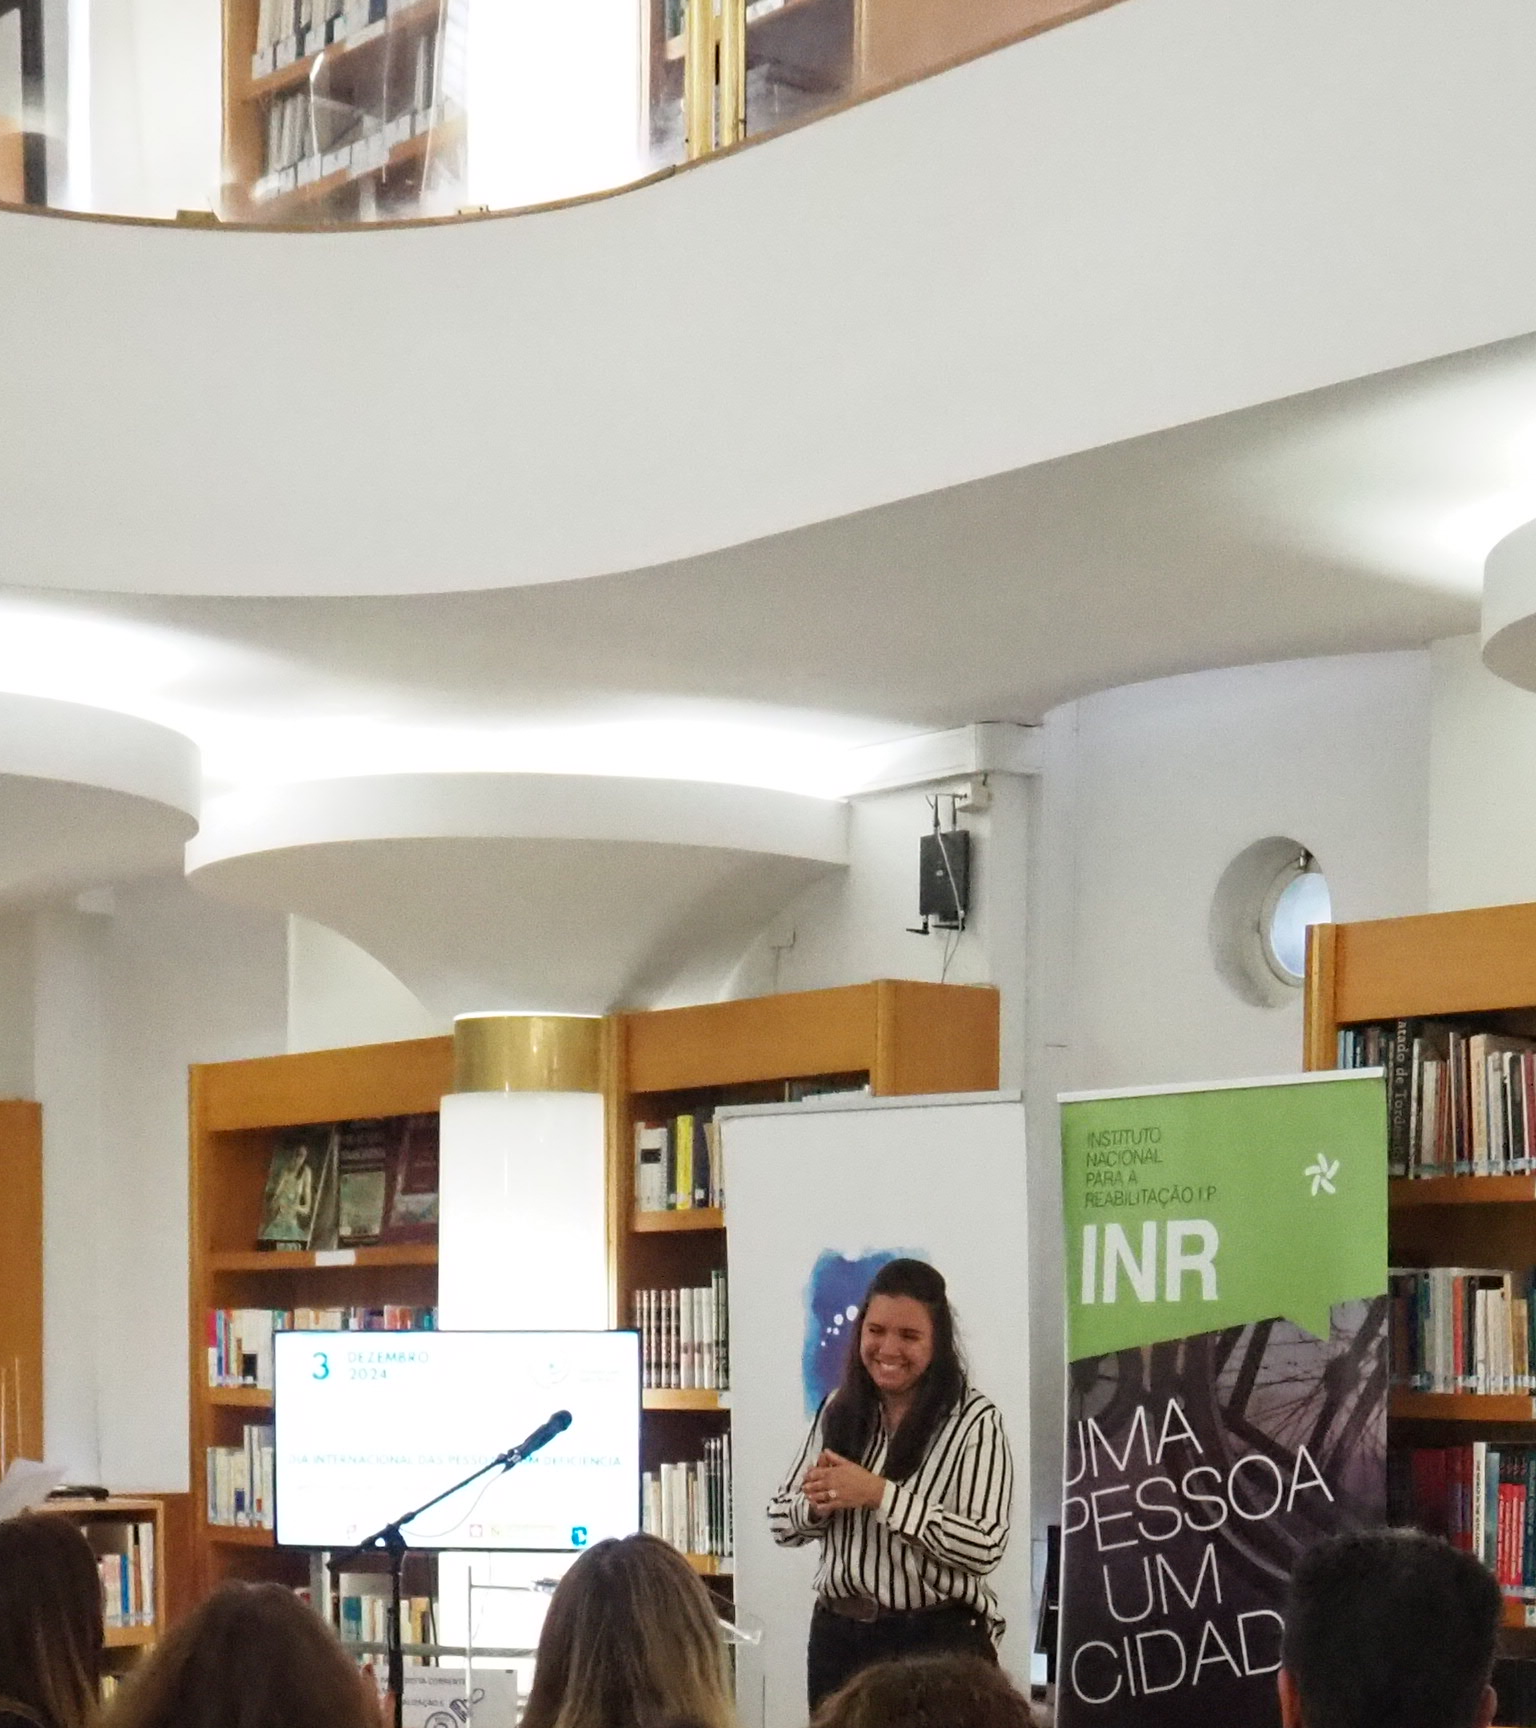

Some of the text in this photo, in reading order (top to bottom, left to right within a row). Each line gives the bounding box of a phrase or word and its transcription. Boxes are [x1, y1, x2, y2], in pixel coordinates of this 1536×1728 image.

[1087, 1127, 1161, 1148] INSTITUTO
[1086, 1148, 1163, 1168] NACIONAL
[1086, 1169, 1137, 1188] PARA A
[1084, 1184, 1193, 1209] REABILITAÇÃO
[1081, 1219, 1220, 1305] INR
[312, 1352, 329, 1380] 3
[347, 1351, 430, 1363] DEZEMBRO
[350, 1367, 388, 1380] 2024
[1062, 1445, 1334, 1551] PESSOA
[1104, 1543, 1222, 1623] UM
[1072, 1609, 1285, 1704] CIDAD
